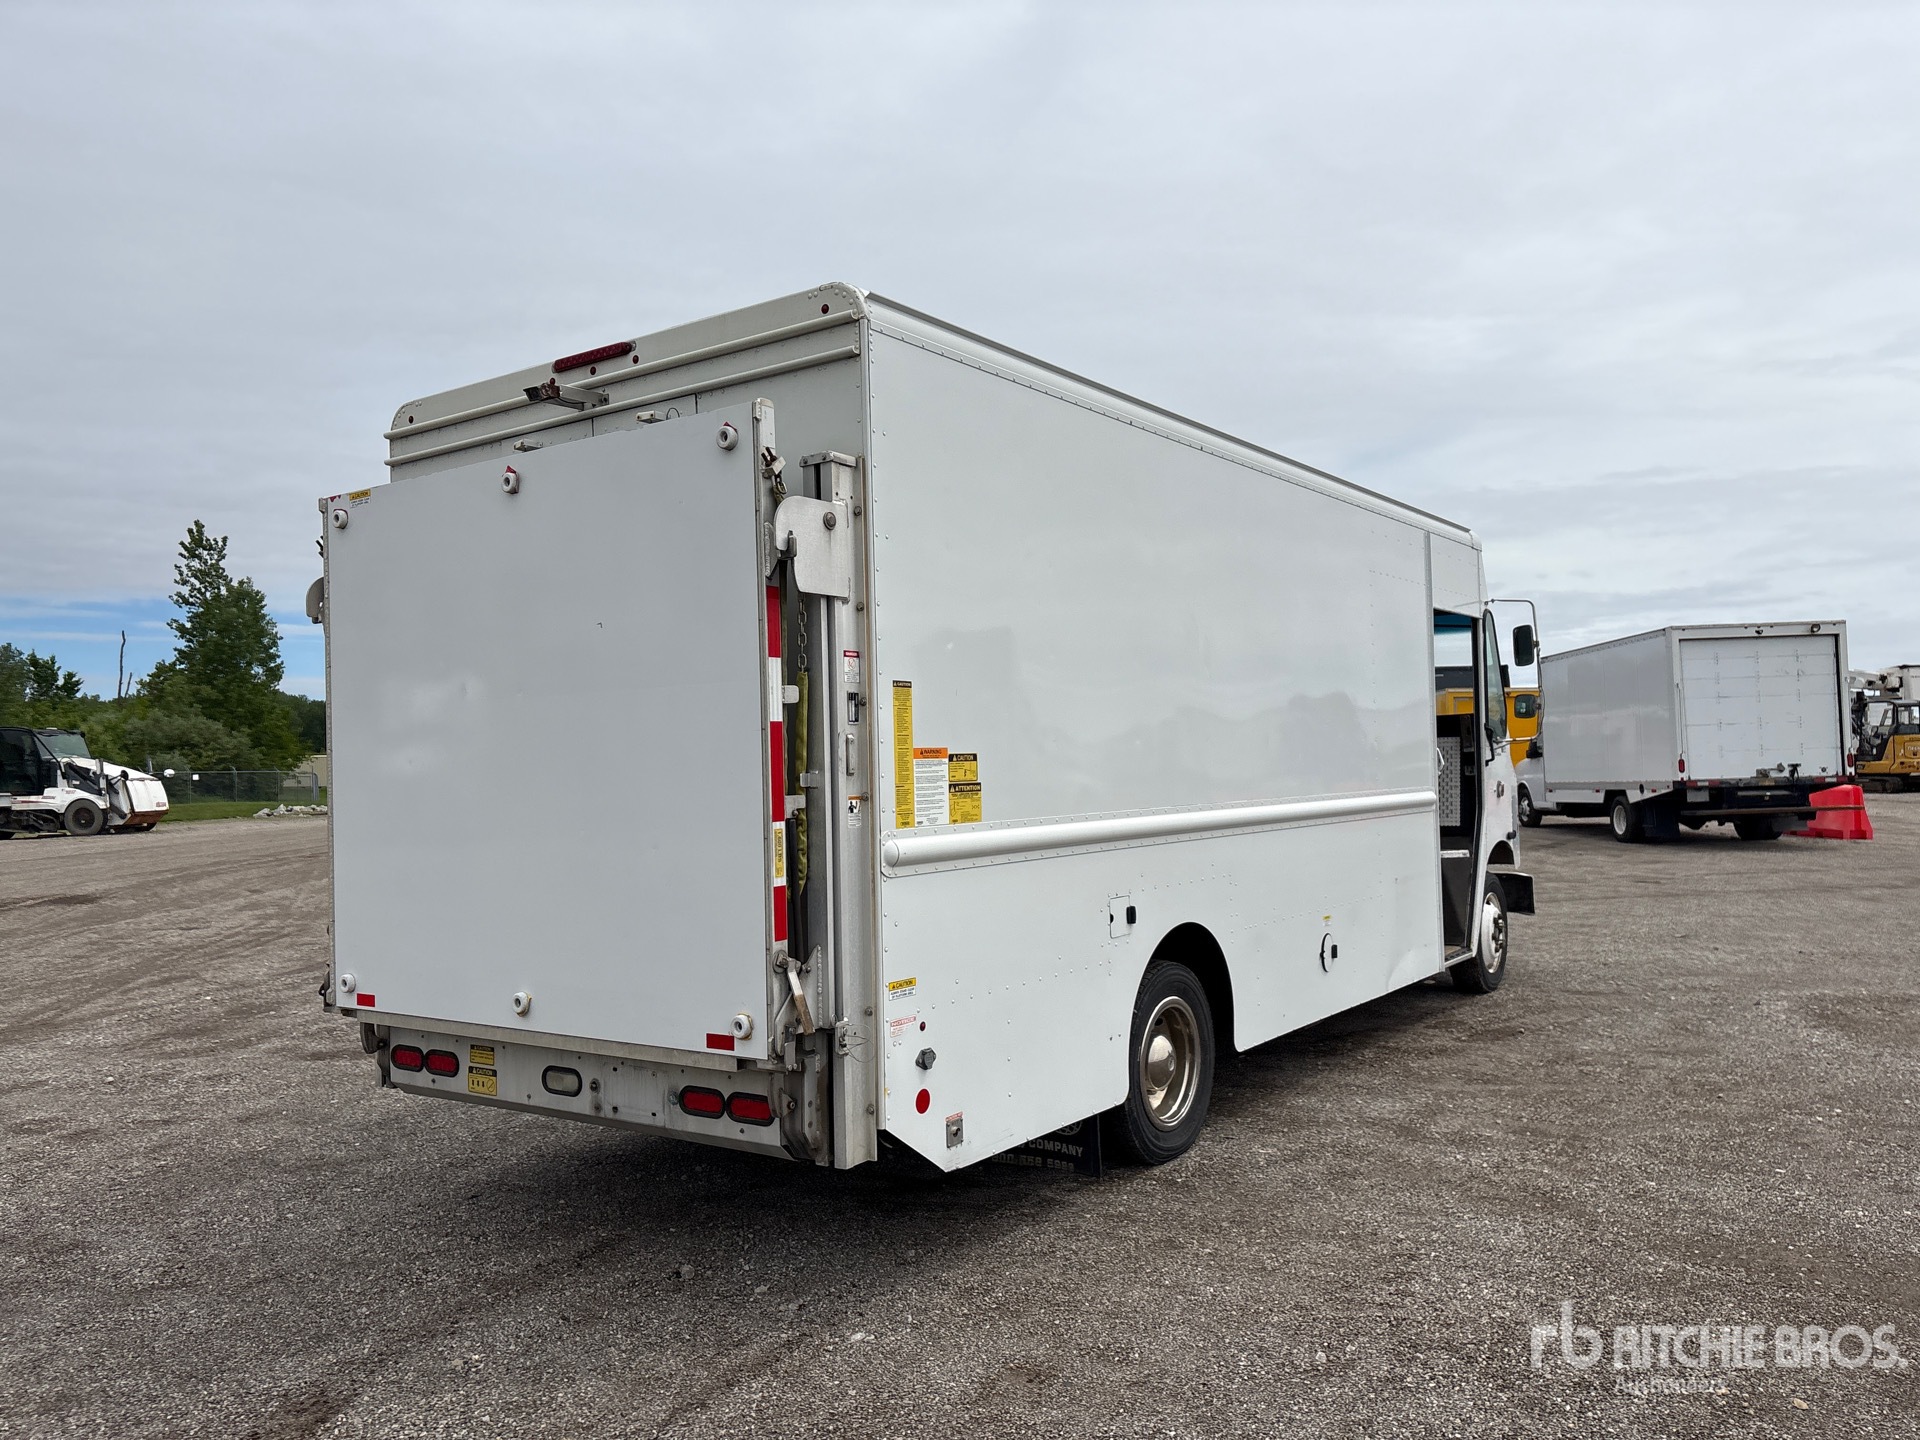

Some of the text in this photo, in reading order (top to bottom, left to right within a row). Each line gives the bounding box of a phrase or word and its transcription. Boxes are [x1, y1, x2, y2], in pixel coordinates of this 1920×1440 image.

[955, 784, 981, 792] ATTENTION
[896, 979, 914, 989] CAUTION
[891, 1015, 915, 1027] NOTICE
[1028, 1138, 1083, 1157] COMPANY
